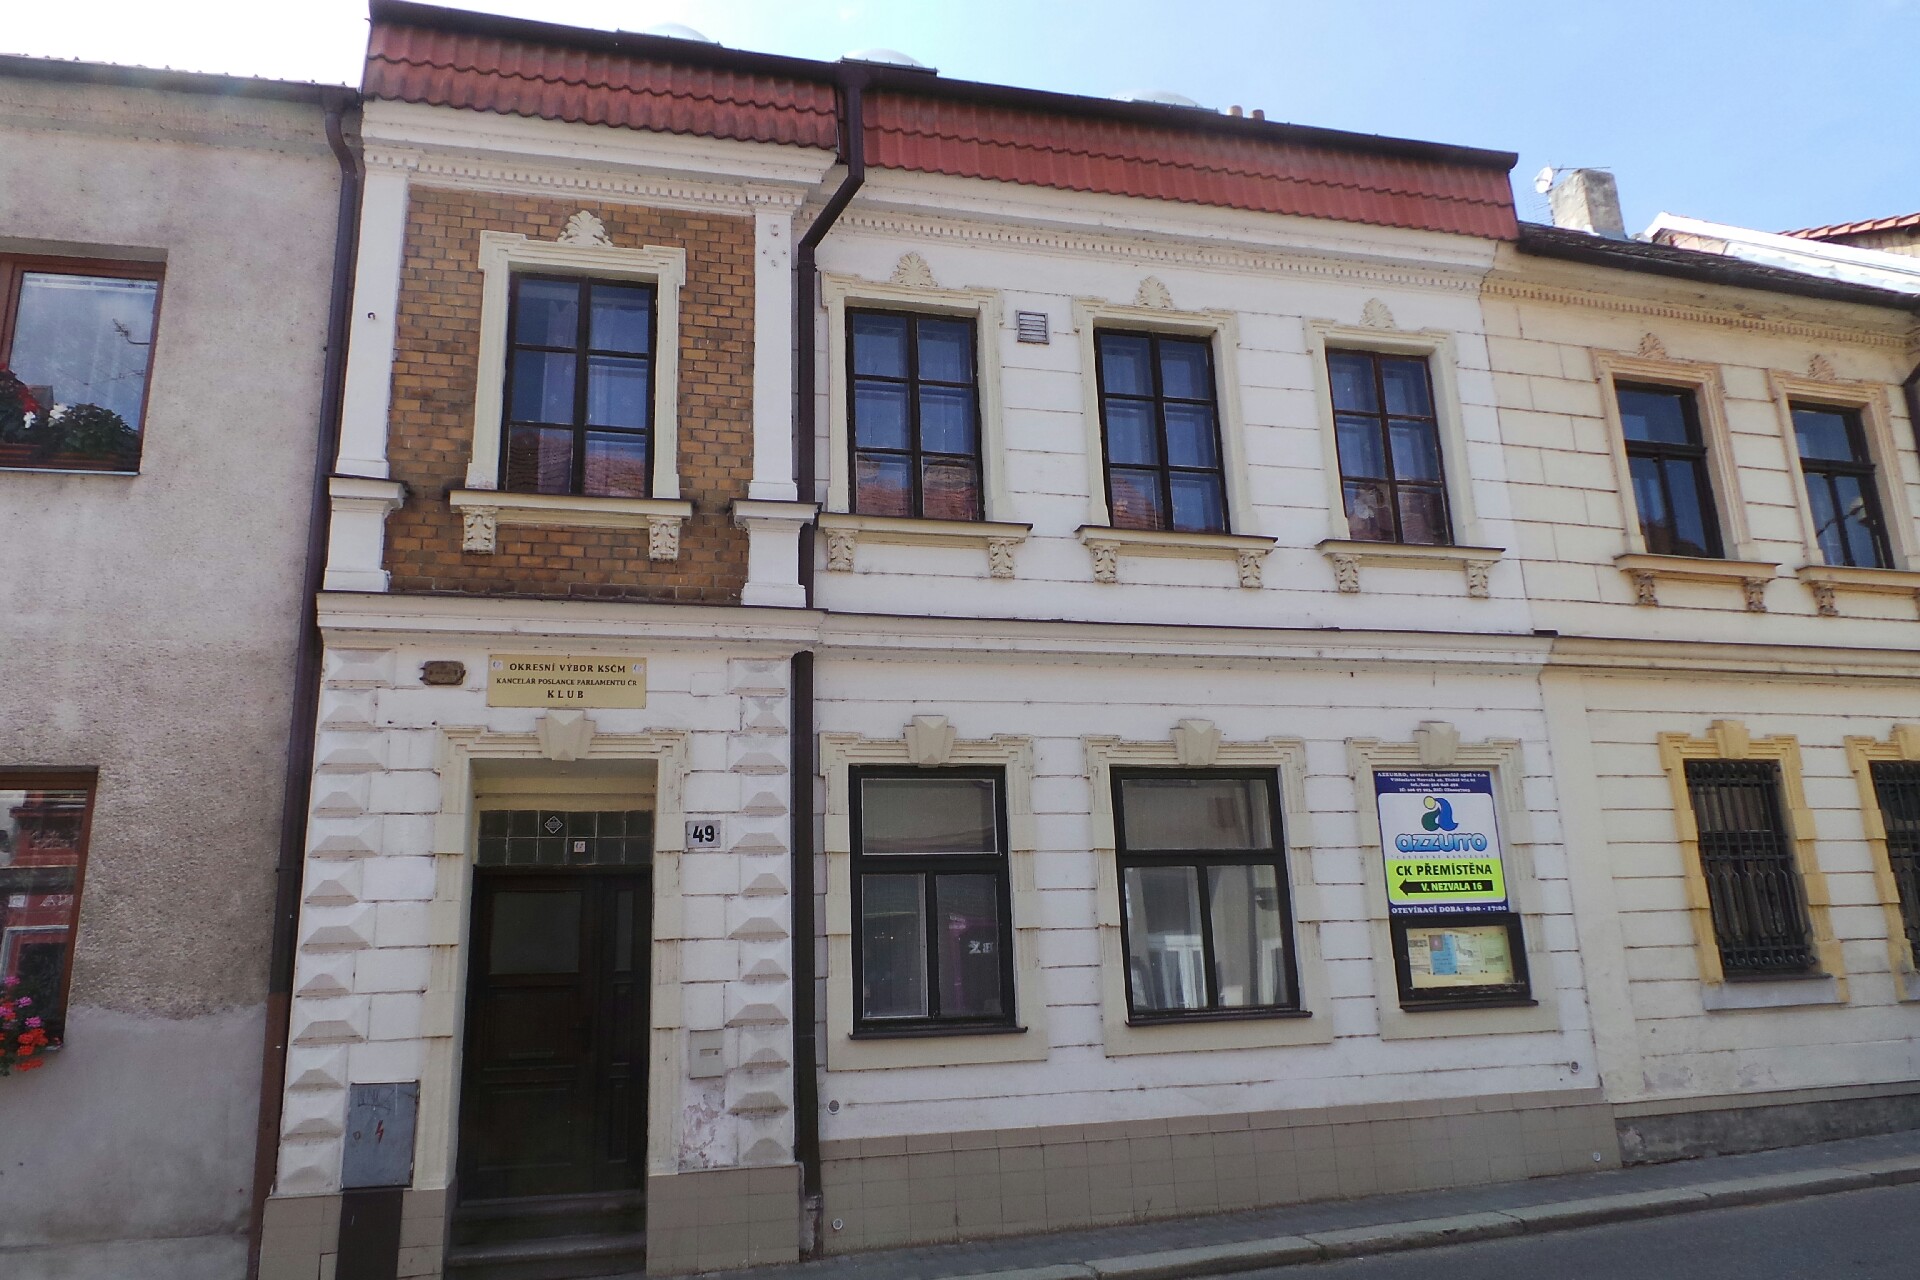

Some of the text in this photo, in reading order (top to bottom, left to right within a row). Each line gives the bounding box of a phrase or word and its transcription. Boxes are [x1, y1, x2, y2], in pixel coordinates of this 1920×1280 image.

[509, 662, 625, 673] OKRESNÍ VÝBOR KSČM
[547, 690, 584, 698] KLUB
[692, 825, 715, 843] 49
[1395, 833, 1488, 852] azzurro
[1396, 862, 1493, 876] CK PŘEMÍSTĚNA
[1420, 882, 1483, 891] V. NEZVALA 16
[1391, 905, 1437, 914] OTEVÍRACÍ
